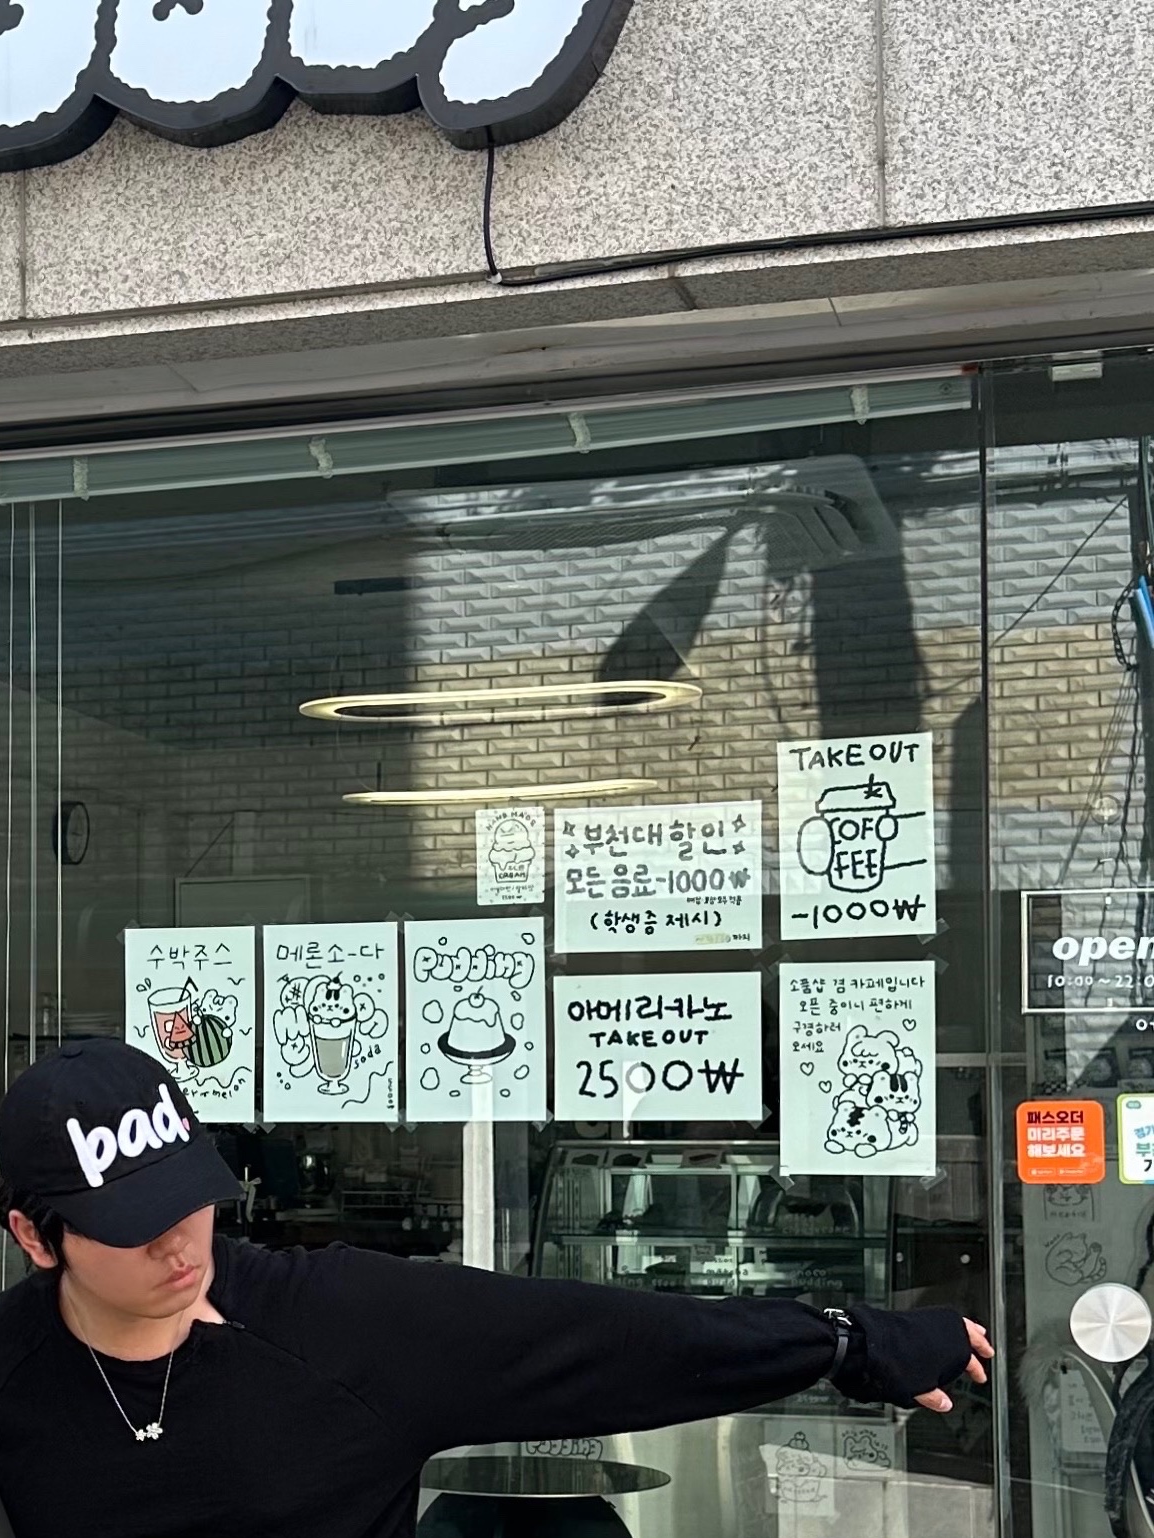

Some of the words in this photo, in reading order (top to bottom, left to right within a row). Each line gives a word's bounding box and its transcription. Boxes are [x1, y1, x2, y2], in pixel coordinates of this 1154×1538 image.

[147, 942, 232, 971] 수박주스
[790, 978, 826, 994] 소품샵
[850, 976, 925, 993] 카페입니다
[567, 994, 732, 1023] 아메리카노
[799, 997, 820, 1016] 오픈
[829, 998, 865, 1015] 중이니
[869, 998, 912, 1013] 편하게
[792, 1040, 824, 1053] 오세요
[353, 1044, 381, 1069] soda
[1027, 1110, 1084, 1125] 패스오더
